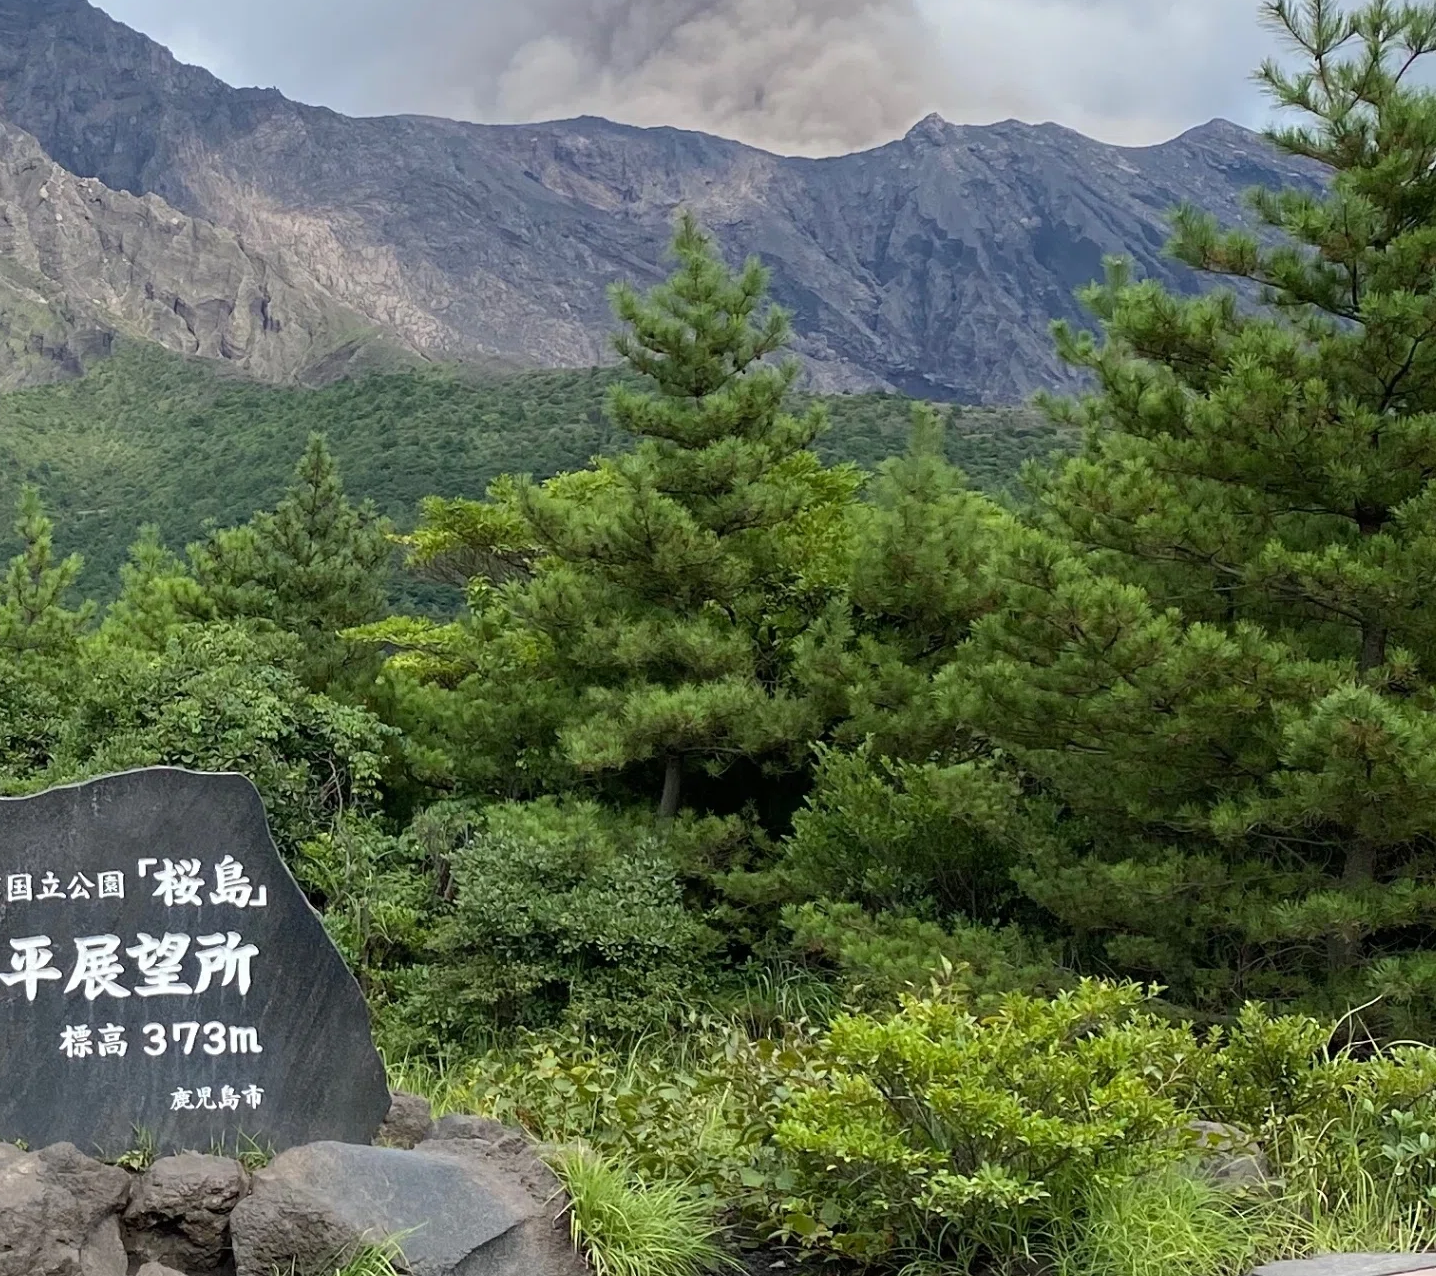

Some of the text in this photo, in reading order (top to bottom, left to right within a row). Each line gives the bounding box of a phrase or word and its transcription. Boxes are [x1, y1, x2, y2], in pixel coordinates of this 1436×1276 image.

[58, 1020, 264, 1059] 標高 373m
[169, 1082, 265, 1112] 鹿児島市
